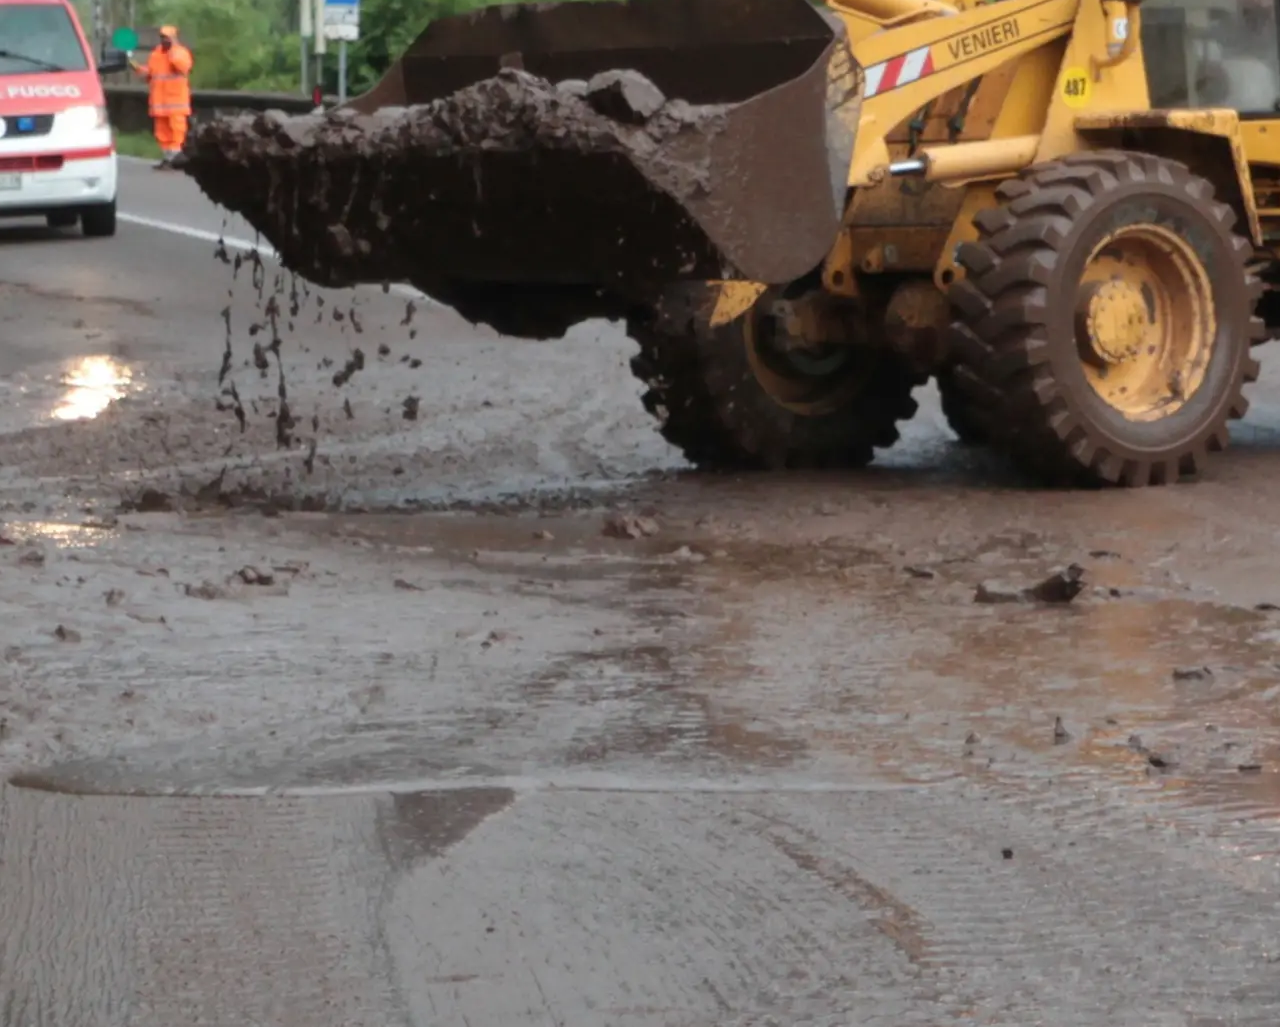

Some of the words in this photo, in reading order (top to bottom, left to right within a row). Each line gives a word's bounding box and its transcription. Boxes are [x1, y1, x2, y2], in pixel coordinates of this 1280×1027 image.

[946, 17, 1020, 60] VENIERI
[6, 84, 82, 99] FUOCO
[1063, 77, 1087, 97] 487
